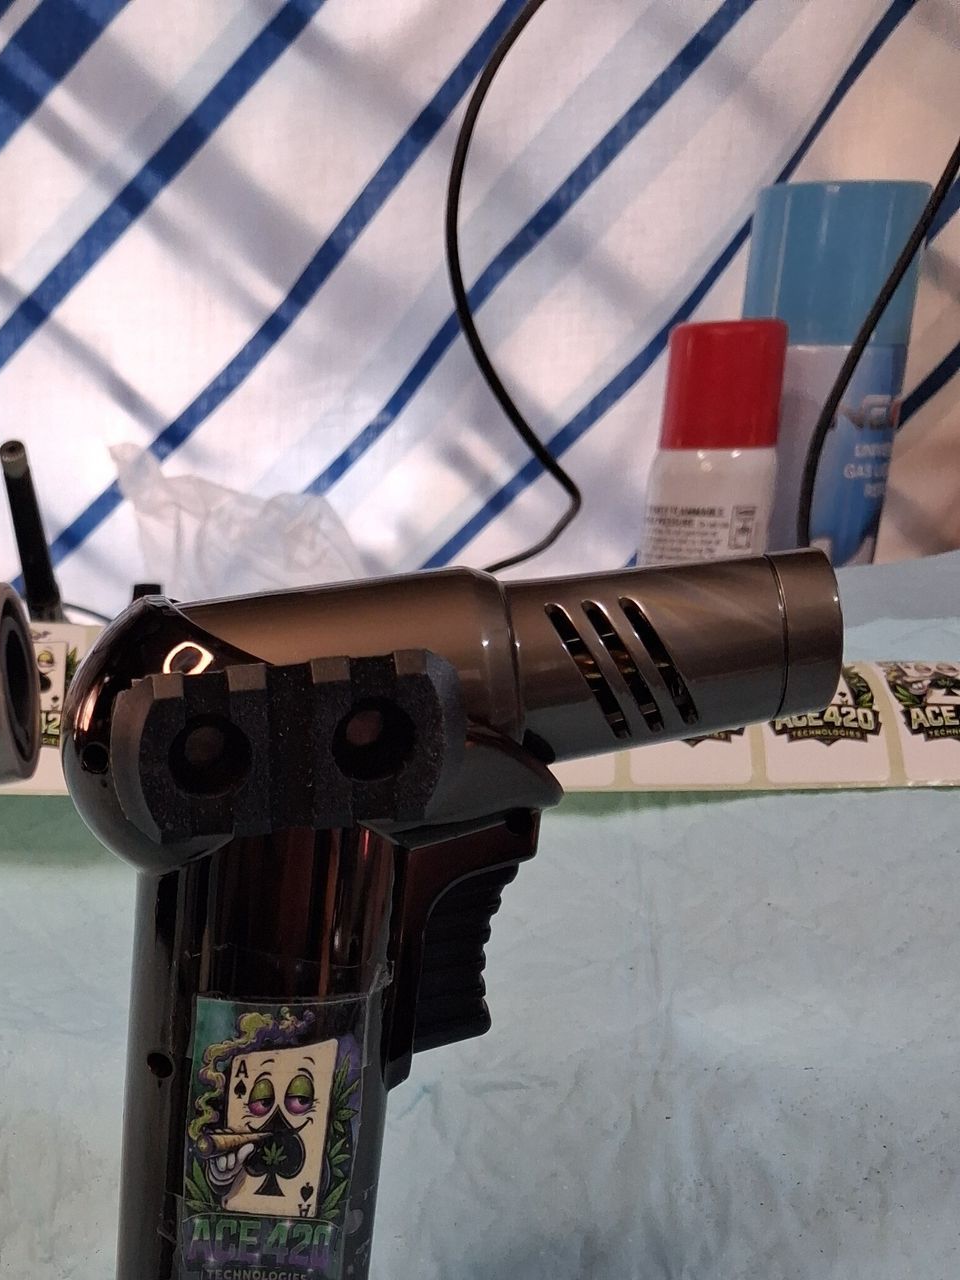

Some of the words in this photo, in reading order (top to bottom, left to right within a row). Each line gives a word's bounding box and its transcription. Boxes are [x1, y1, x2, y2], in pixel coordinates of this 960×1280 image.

[823, 705, 875, 730] 420
[910, 705, 960, 730] ACE
[235, 1059, 249, 1079] A
[188, 1217, 262, 1263] ACE
[262, 1221, 332, 1270] 420
